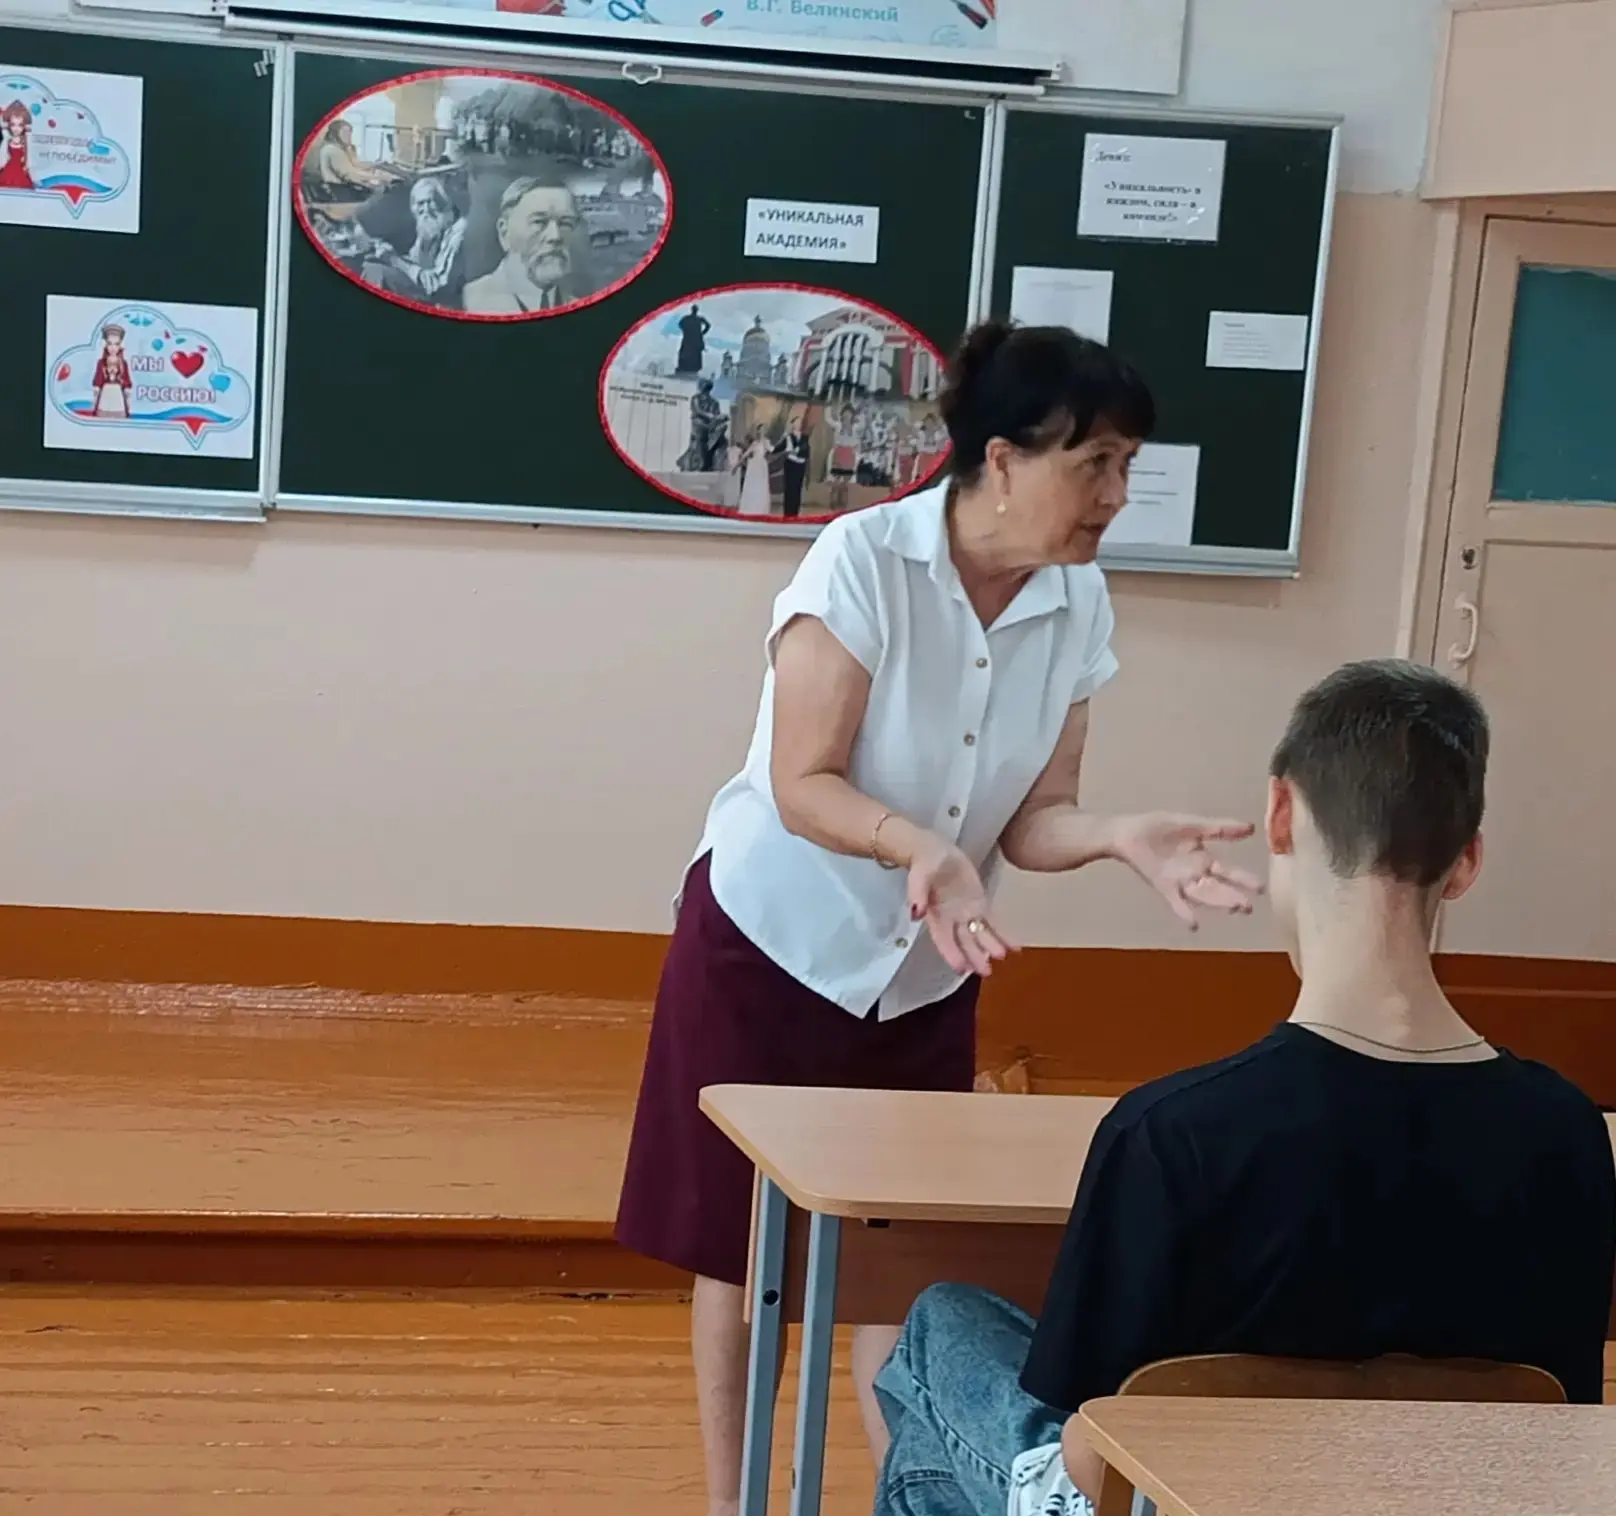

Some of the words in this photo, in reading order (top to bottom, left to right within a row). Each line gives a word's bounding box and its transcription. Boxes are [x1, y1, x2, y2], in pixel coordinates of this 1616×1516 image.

[758, 208, 865, 227] «УНИКАЛЬНАЯ
[756, 232, 847, 251] АКАДЕМИЯ»
[131, 354, 165, 373] МЫ
[136, 385, 216, 404] РОССИЮ!
